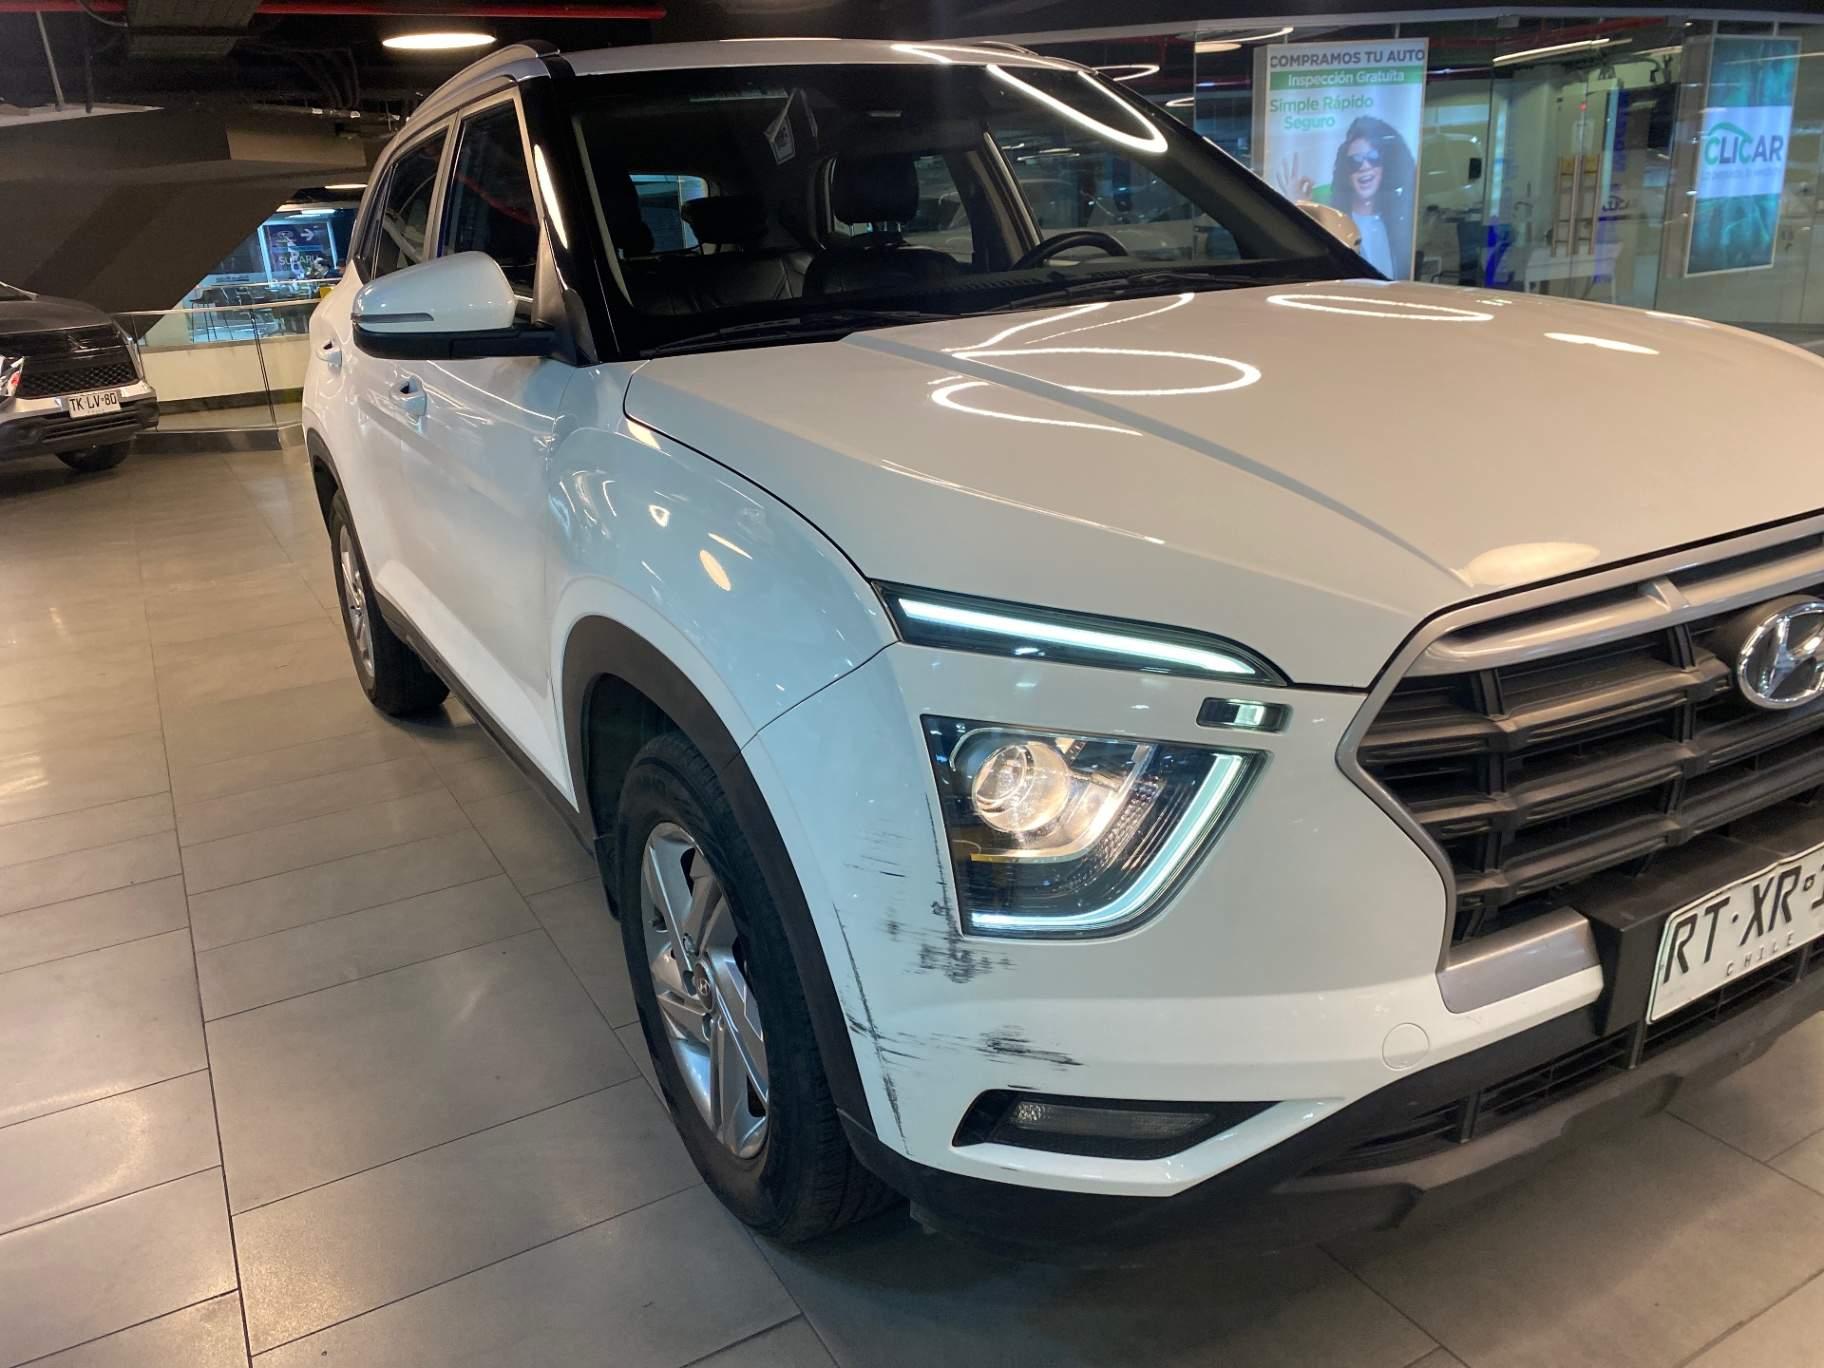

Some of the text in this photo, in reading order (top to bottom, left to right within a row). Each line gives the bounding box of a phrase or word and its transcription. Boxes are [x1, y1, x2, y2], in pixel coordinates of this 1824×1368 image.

[1270, 49, 1425, 67] COMPRAMOS TU AUTO
[1288, 70, 1405, 88] Inspección Gratuita
[1270, 94, 1374, 114] Simple Rápido
[1284, 115, 1336, 131] Seguro
[1705, 133, 1784, 165] CLICAR
[1727, 932, 1793, 976] CHILE
